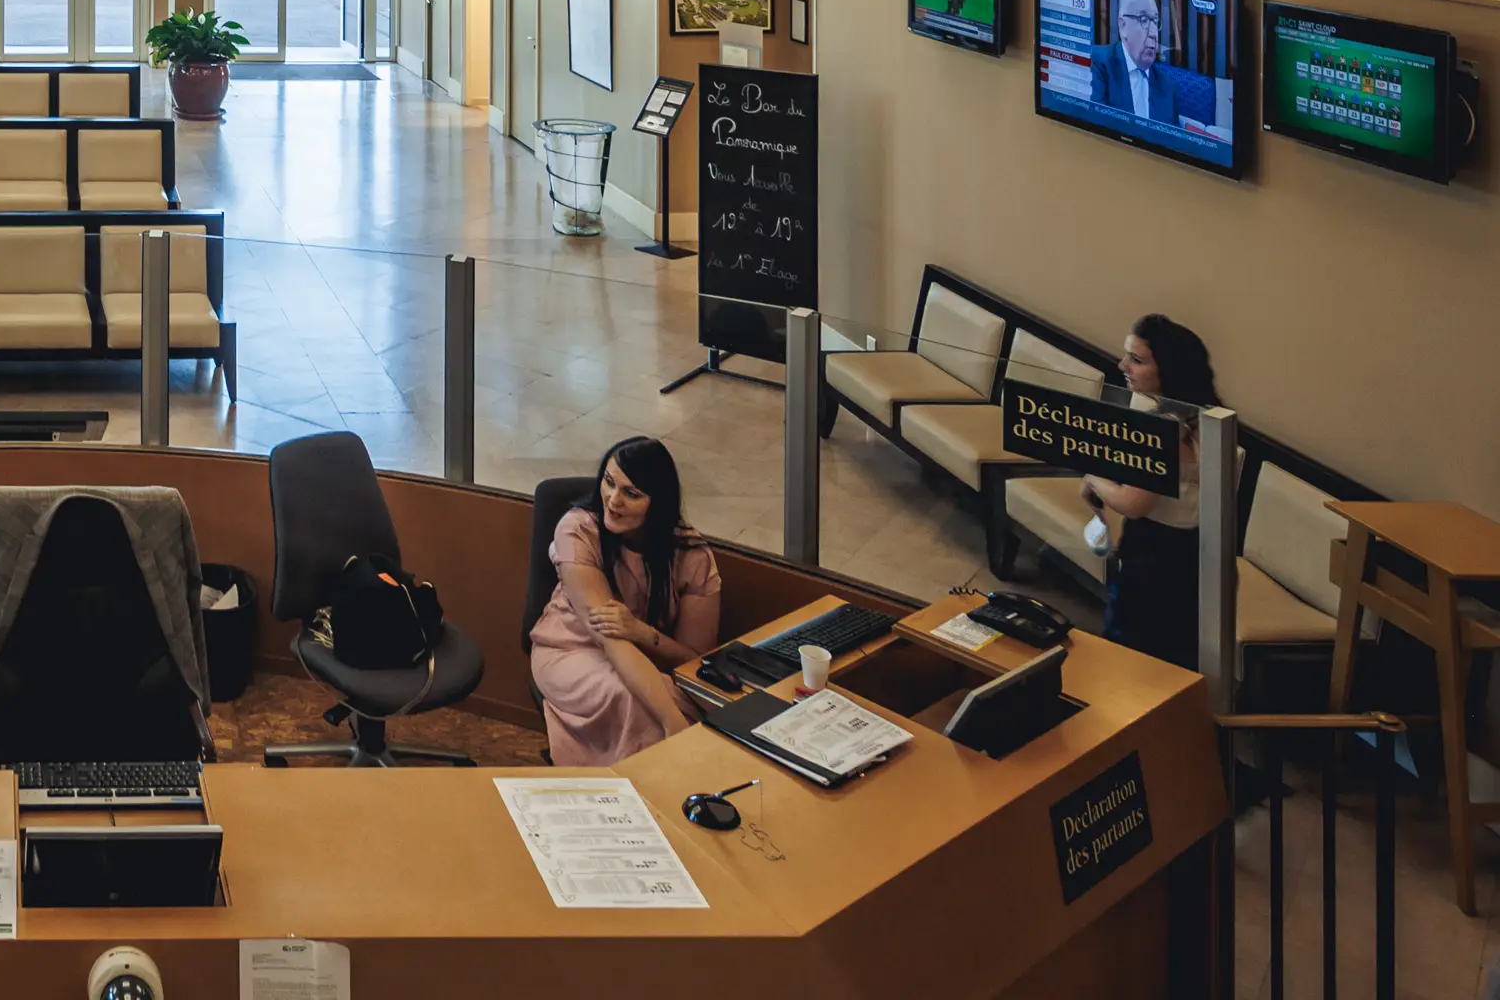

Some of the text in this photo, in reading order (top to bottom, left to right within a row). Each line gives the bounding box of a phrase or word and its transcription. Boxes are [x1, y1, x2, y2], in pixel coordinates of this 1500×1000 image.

[1316, 24, 1336, 33] CLOUD
[708, 81, 731, 106] Le
[741, 83, 780, 113] Bar
[786, 98, 806, 117] du
[712, 117, 800, 160] Panoramique
[708, 162, 736, 182] Vous
[742, 196, 761, 212] de
[1017, 395, 1163, 450] Déclaration
[1013, 419, 1167, 476] des partants
[1066, 807, 1144, 875] des partants
